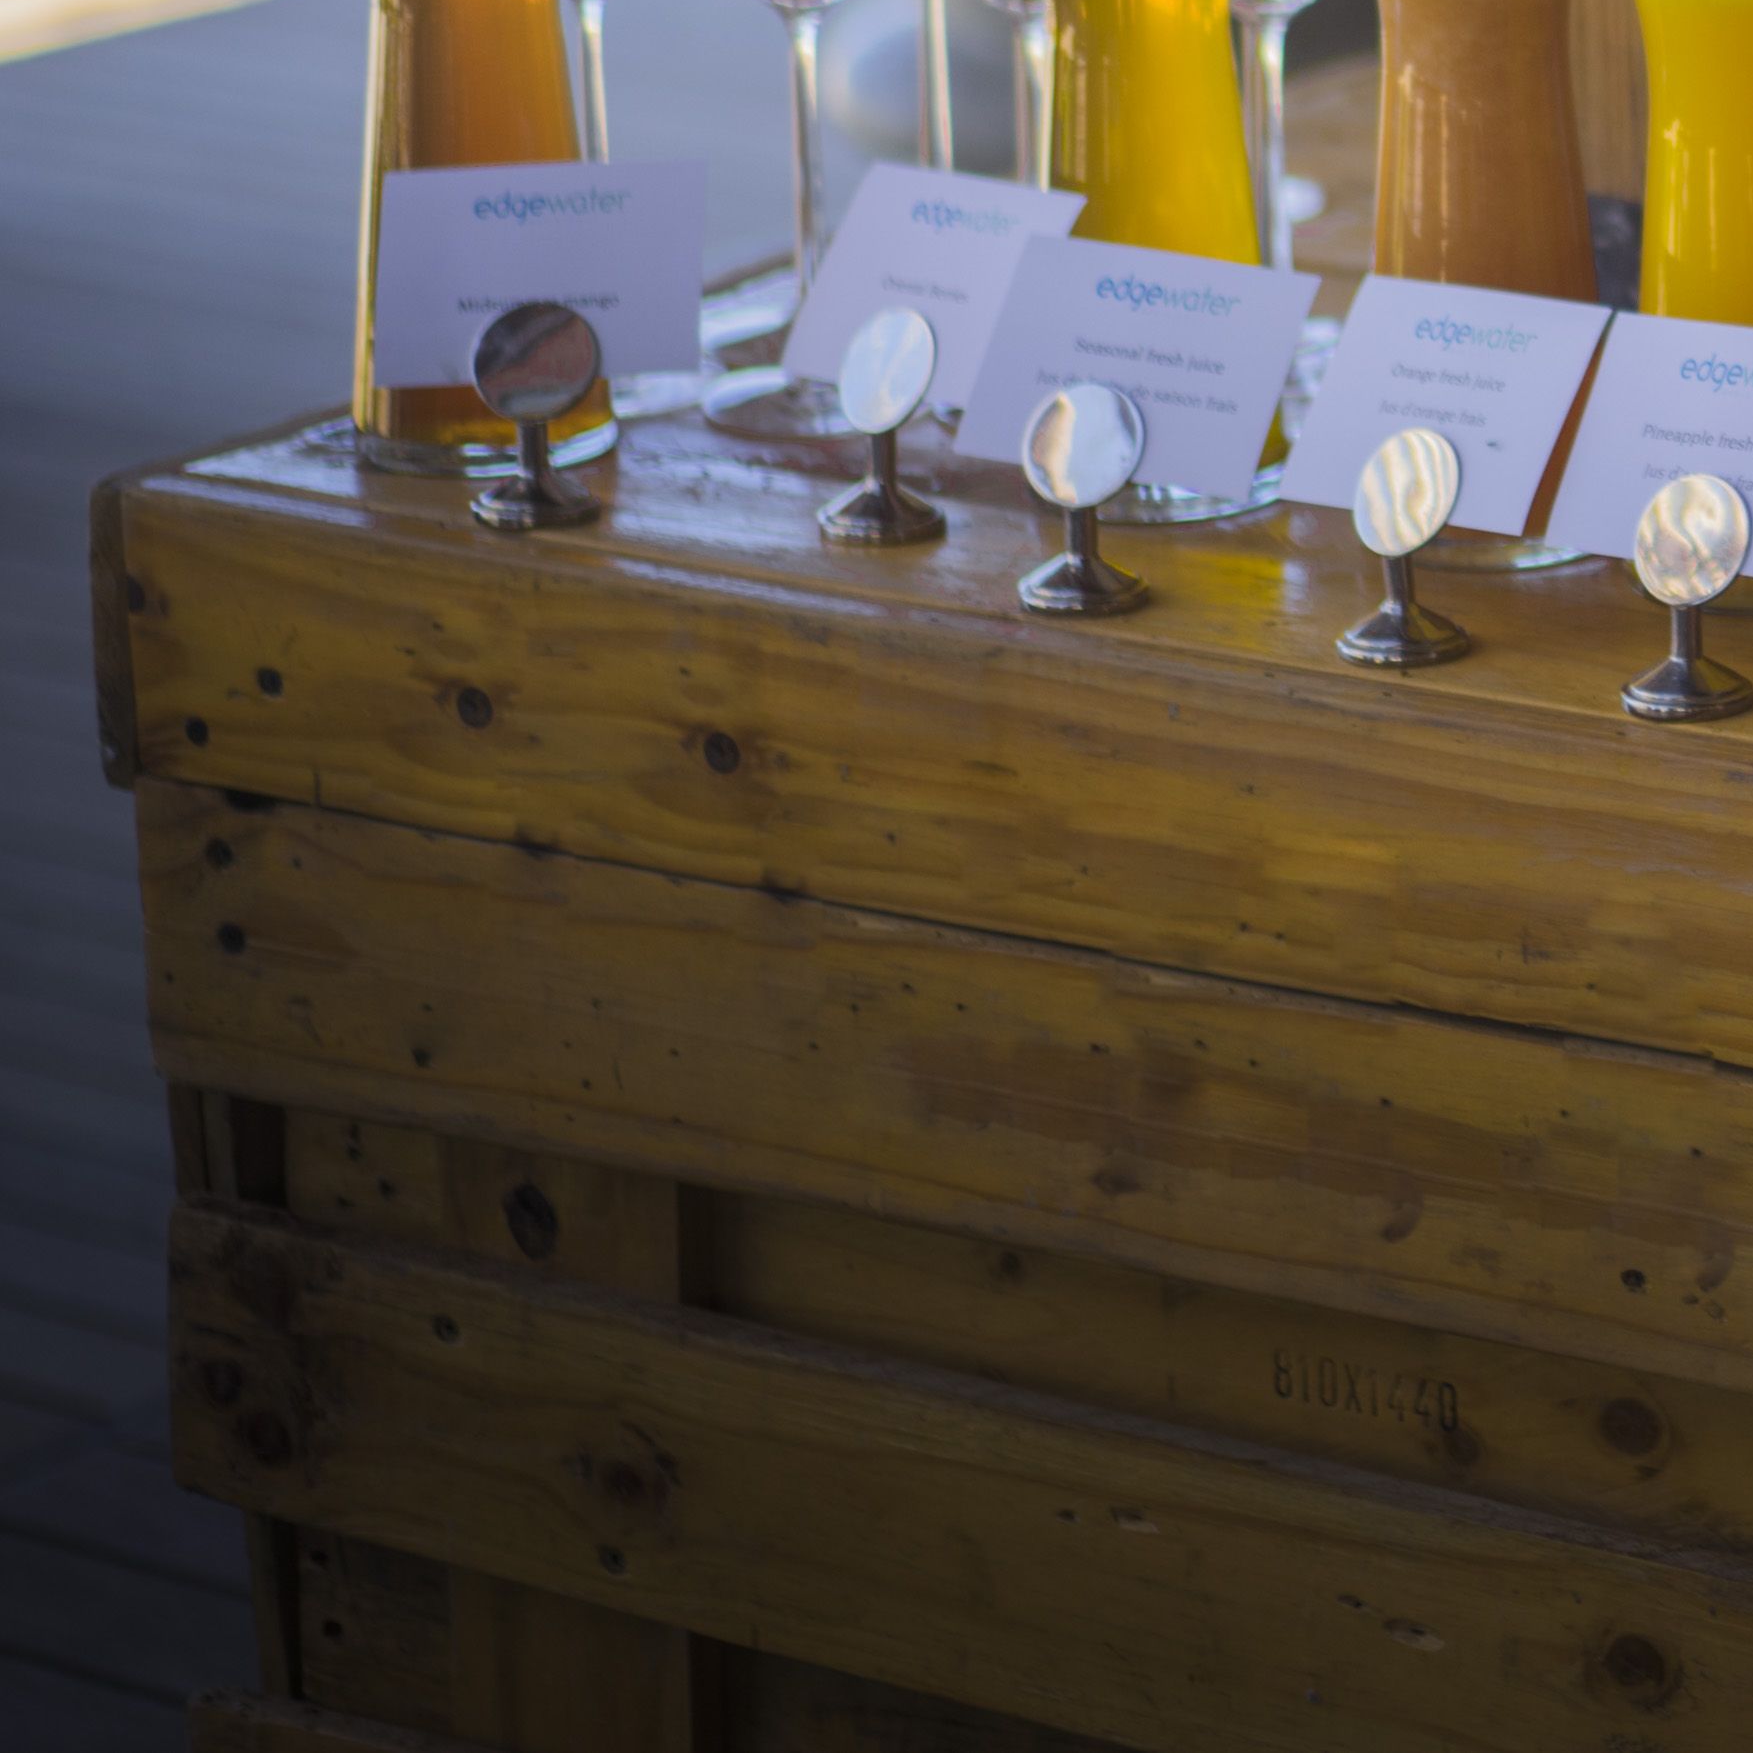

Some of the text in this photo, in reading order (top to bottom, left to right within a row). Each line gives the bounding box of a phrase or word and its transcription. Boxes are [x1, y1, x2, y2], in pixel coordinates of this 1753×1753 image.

[473, 187, 629, 224] edgewater
[1096, 272, 1242, 316] edgewater
[1414, 314, 1538, 352] edgewater
[1074, 337, 1226, 375] Seasonal fresh juice
[1391, 362, 1506, 393] Orange fresh juice
[1154, 390, 1201, 408] saison
[1205, 395, 1239, 415] frais
[1459, 409, 1487, 428] frais
[1641, 423, 1715, 447] Pineapple
[1717, 431, 1753, 453] fresh
[1643, 463, 1665, 479] Jus
